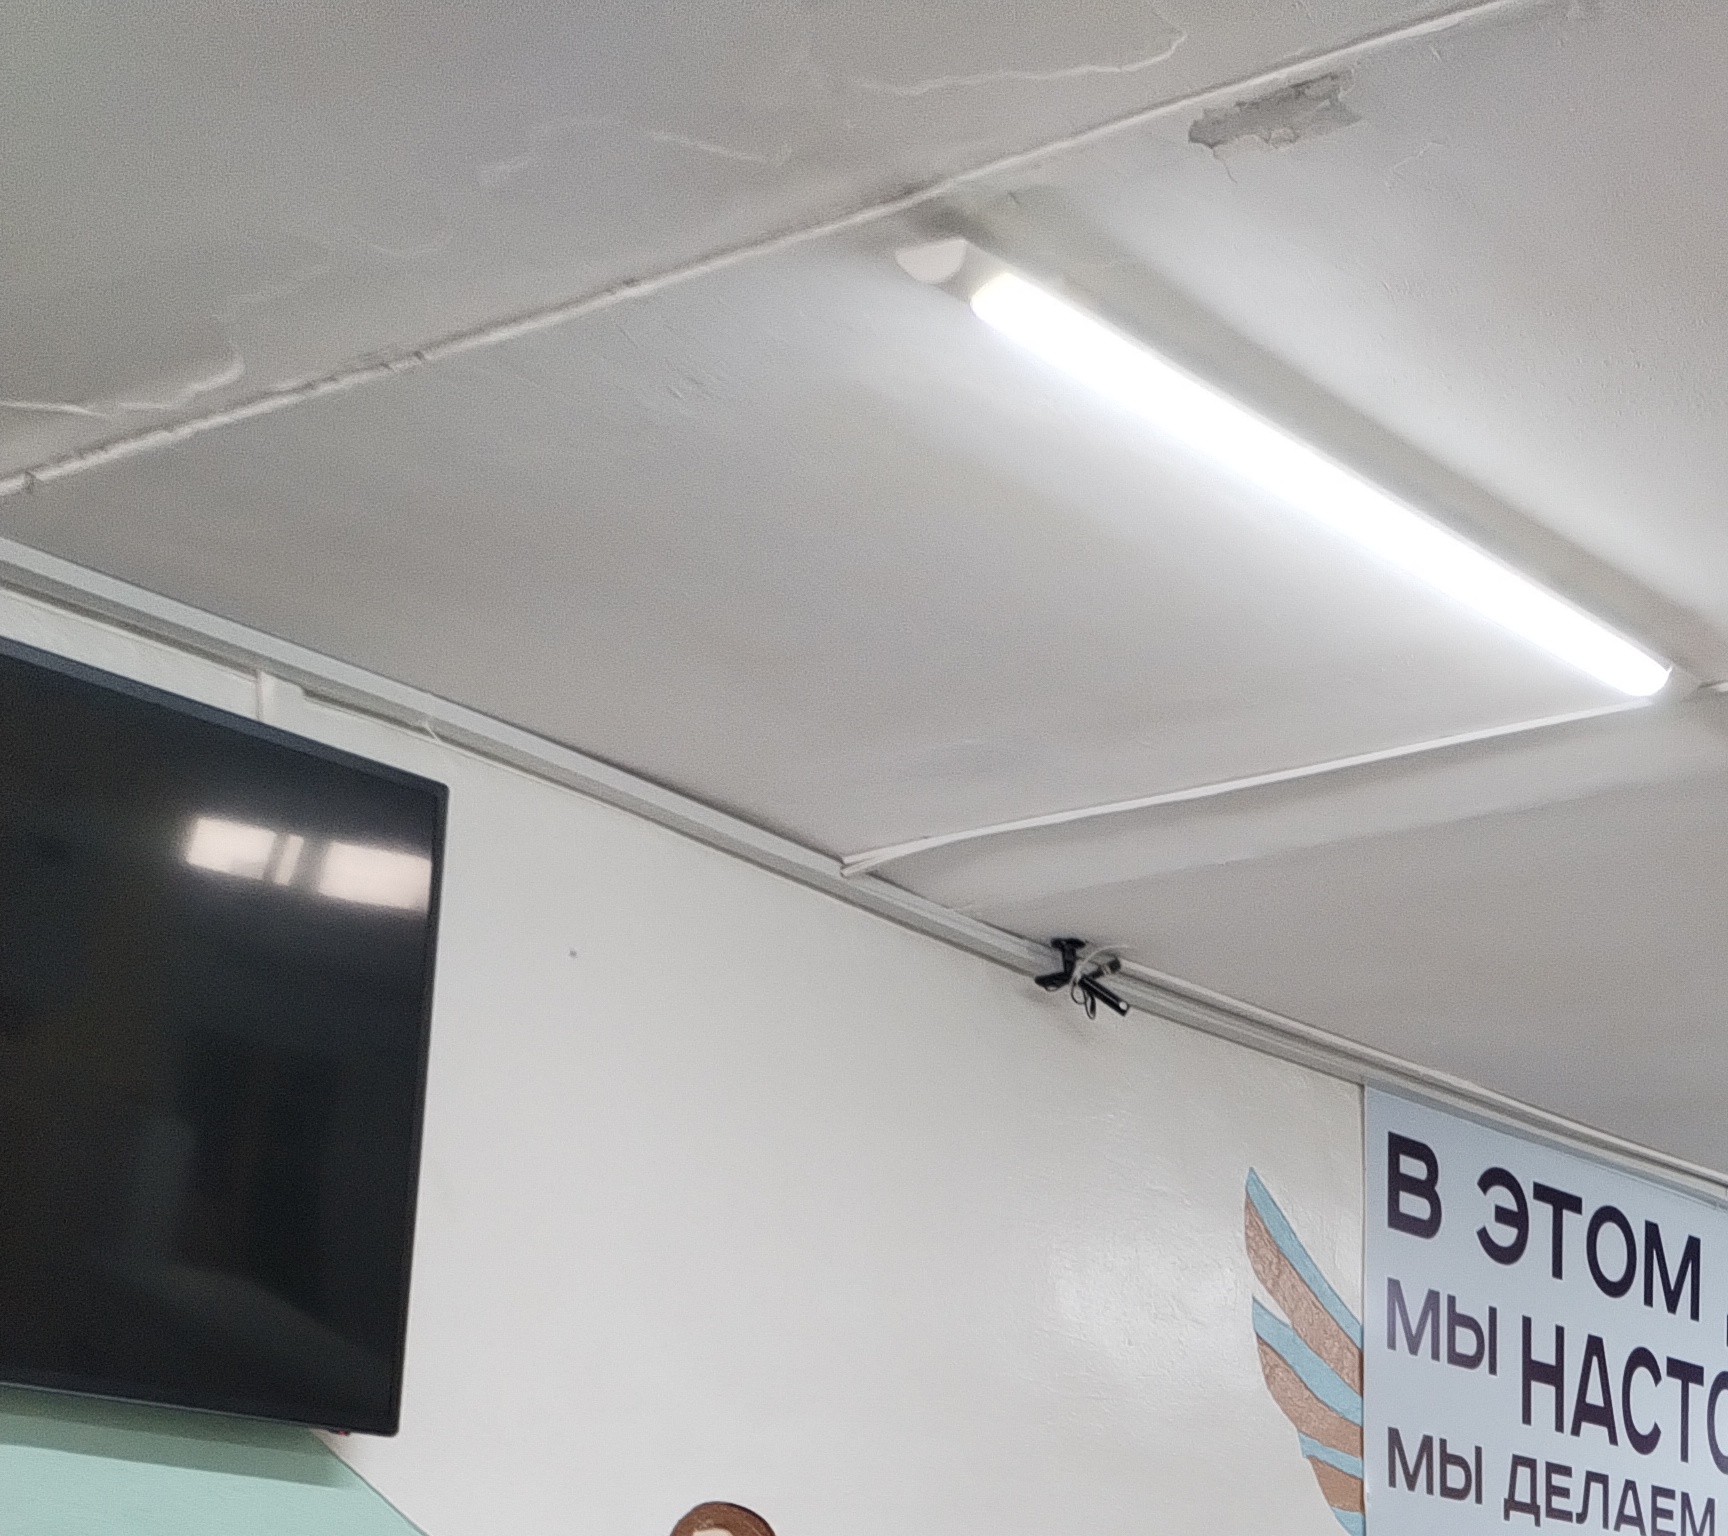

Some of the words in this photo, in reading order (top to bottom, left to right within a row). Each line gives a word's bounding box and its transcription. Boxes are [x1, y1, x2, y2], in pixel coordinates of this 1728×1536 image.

[1387, 1131, 1443, 1239] В
[1476, 1166, 1702, 1322] ЭТОМ
[1386, 1276, 1498, 1376] МЫ
[1387, 1426, 1483, 1505] МЫ
